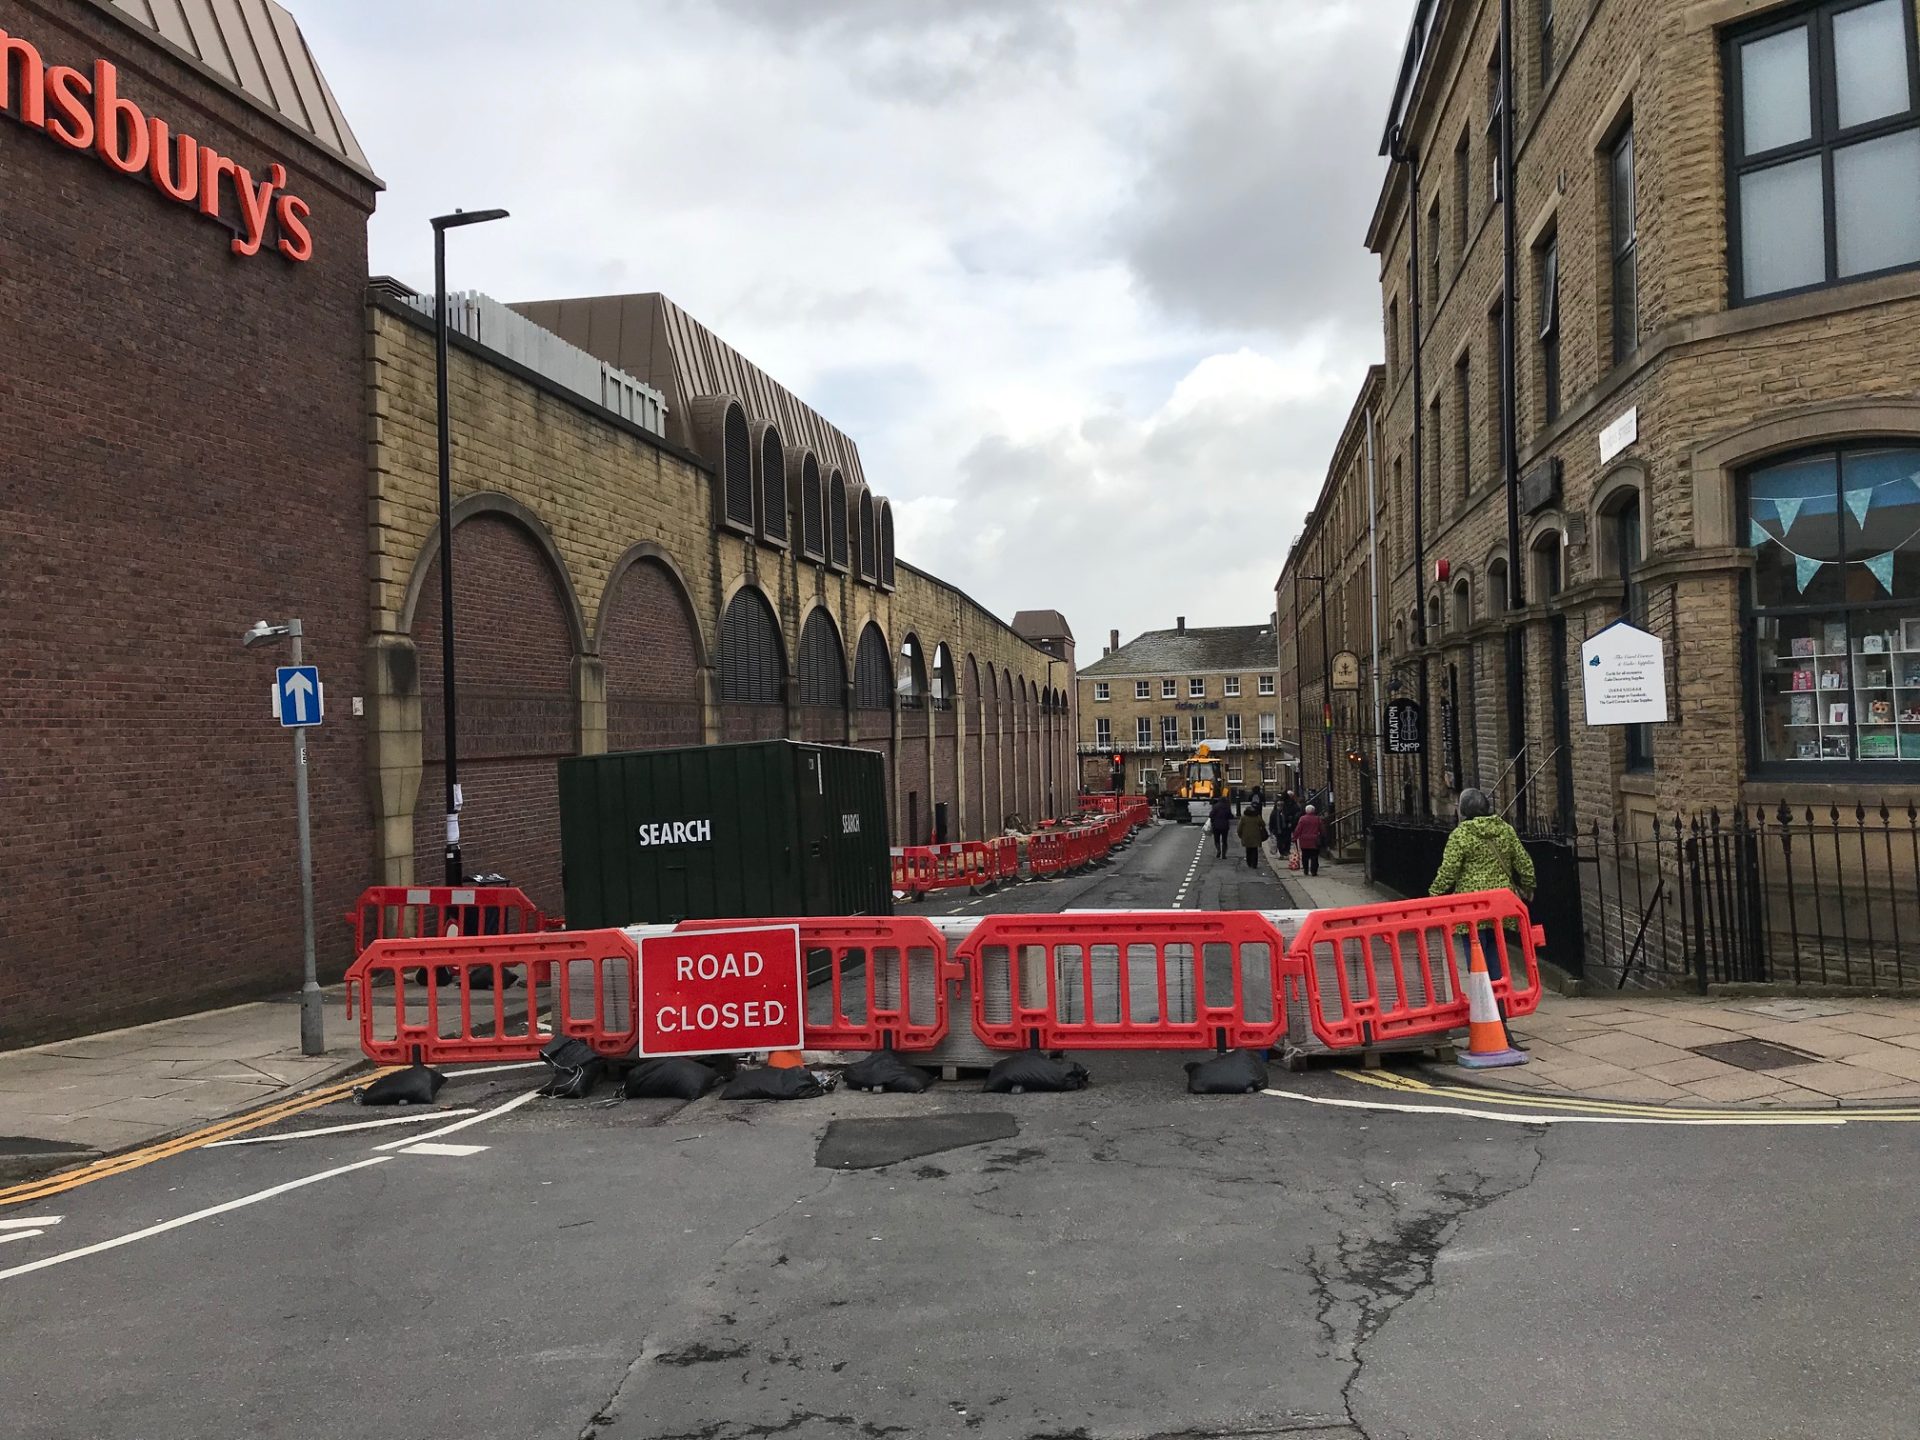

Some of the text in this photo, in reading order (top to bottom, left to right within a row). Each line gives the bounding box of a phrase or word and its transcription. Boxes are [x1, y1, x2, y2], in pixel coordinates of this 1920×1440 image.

[1400, 742, 1420, 752] SHOP
[639, 819, 711, 847] SEARCH
[842, 813, 860, 834] SEARCH
[677, 951, 764, 981] ROAD
[656, 1000, 785, 1033] CLOSED
